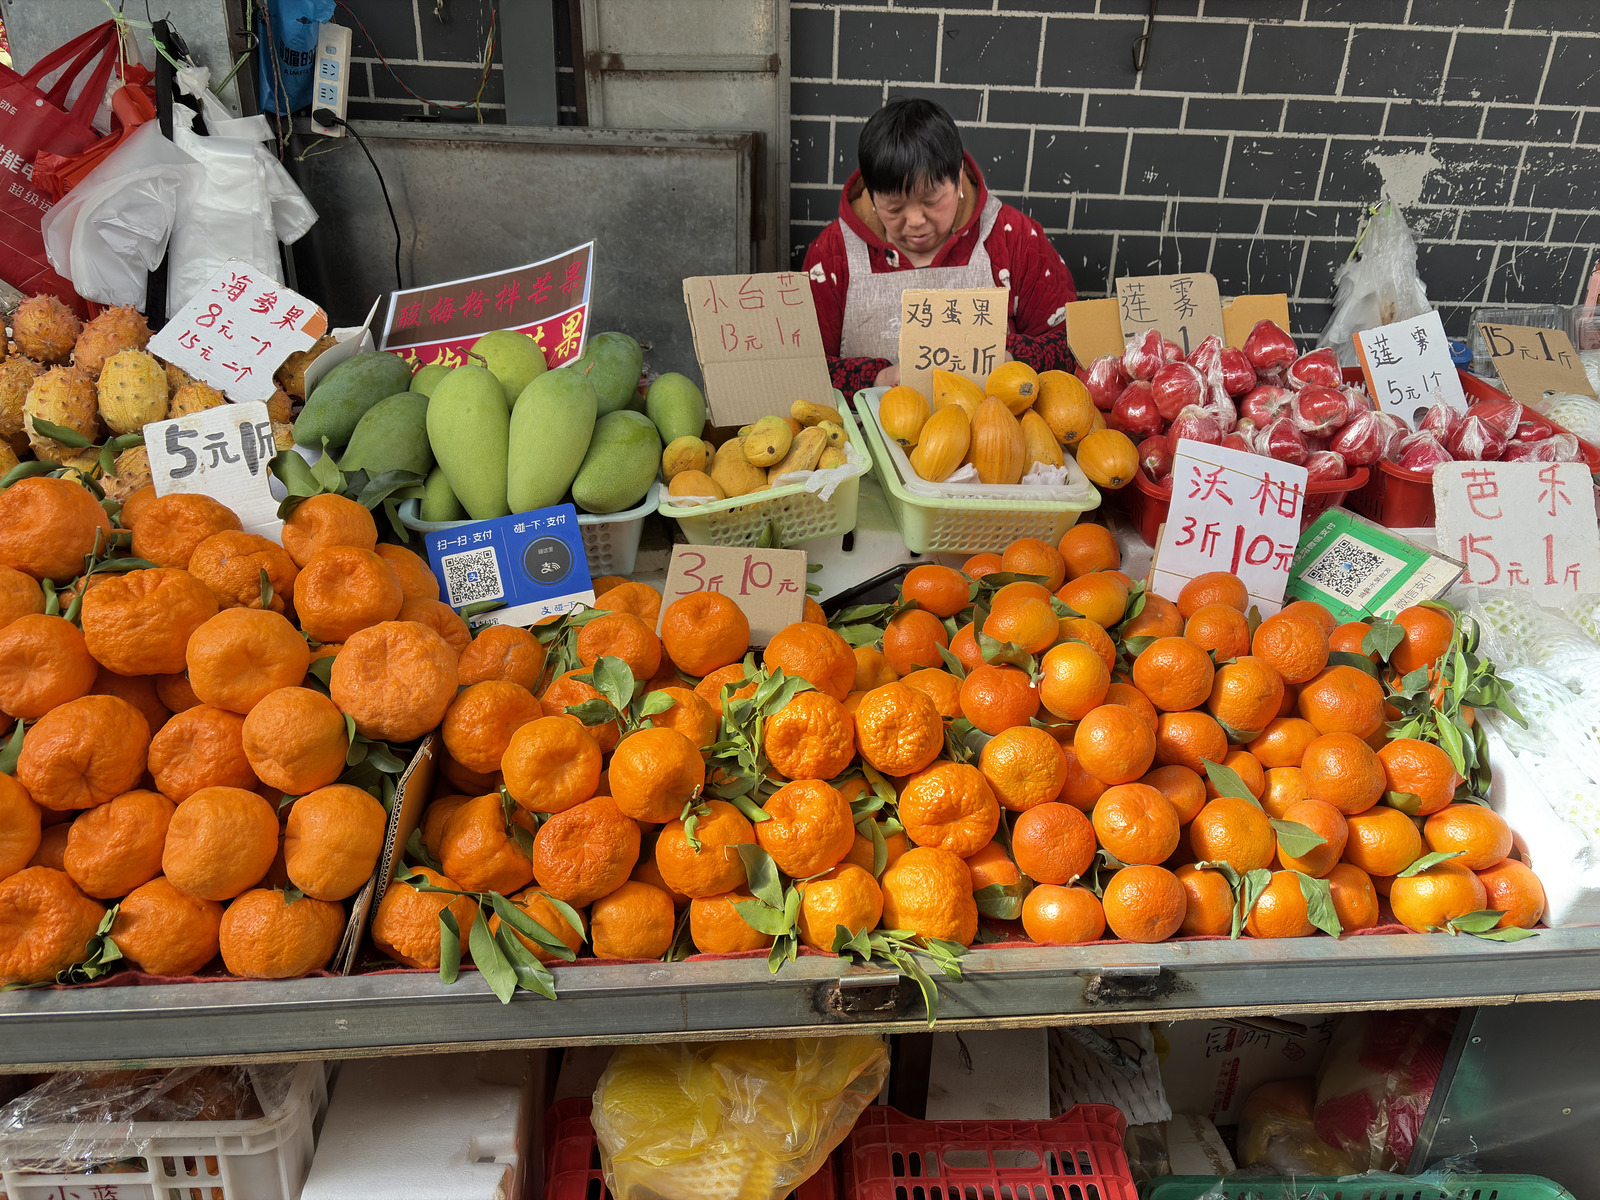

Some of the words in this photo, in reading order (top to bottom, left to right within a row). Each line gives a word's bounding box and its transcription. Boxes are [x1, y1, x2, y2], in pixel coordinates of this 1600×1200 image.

[396, 260, 582, 328] 酸梅粉拌芒果
[703, 273, 804, 314] 小台芒
[906, 298, 993, 328] 鸡蛋果
[1121, 277, 1198, 323] 莲雾
[1368, 326, 1430, 368] 莲雾
[1188, 465, 1303, 519] 沃柑
[1461, 464, 1572, 520] 芭乐
[1393, 572, 1436, 610] 微信支付
